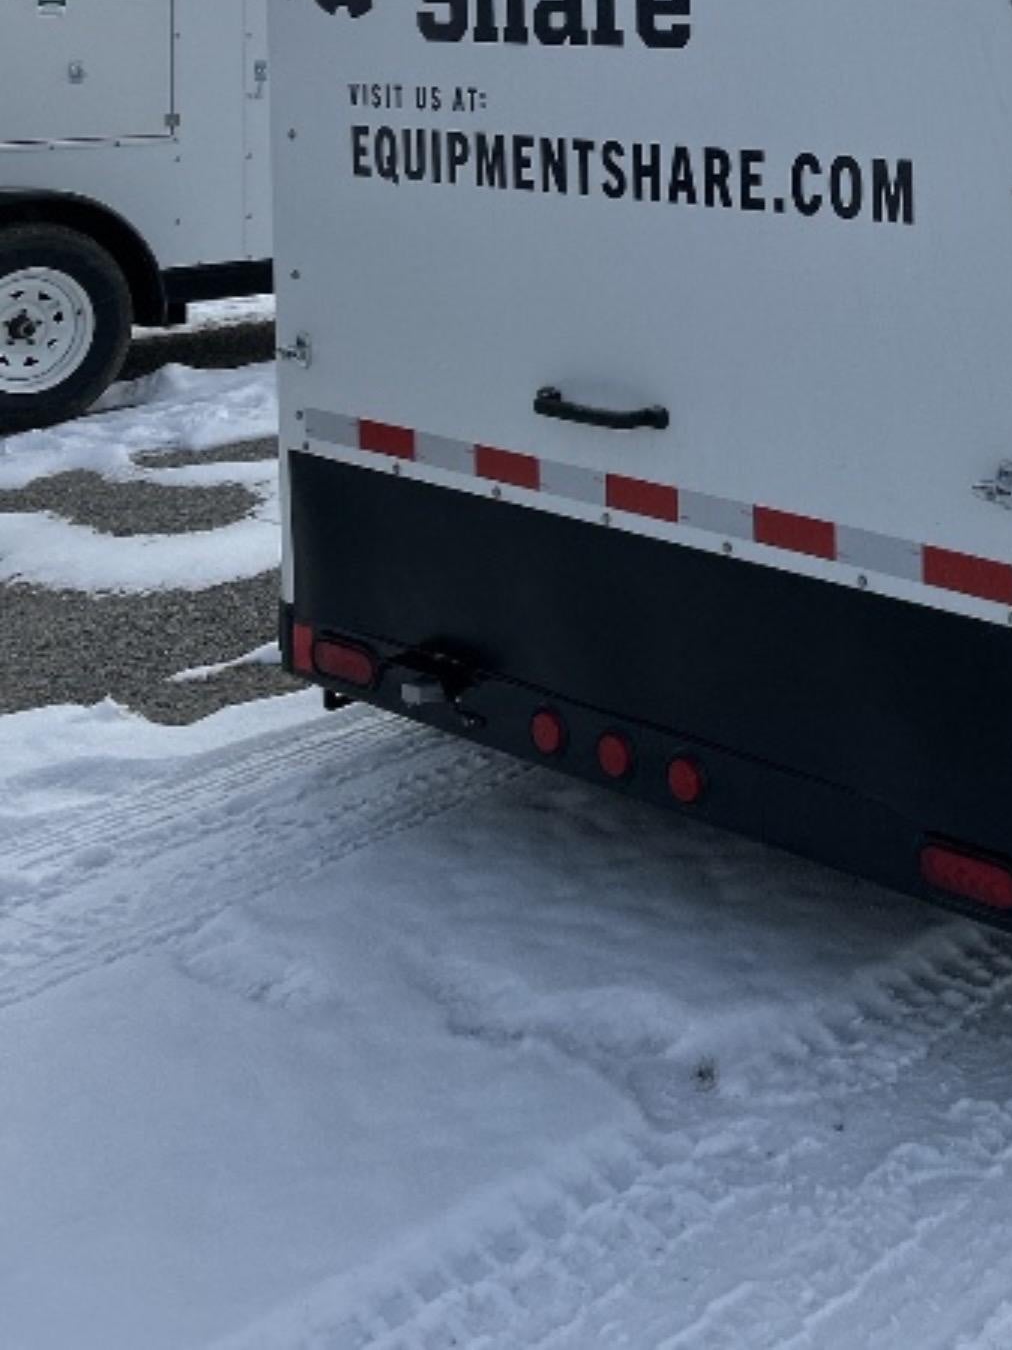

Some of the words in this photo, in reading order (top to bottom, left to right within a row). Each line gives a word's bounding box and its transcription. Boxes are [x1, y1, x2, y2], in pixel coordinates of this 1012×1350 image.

[348, 83, 403, 110] VISIT
[415, 86, 443, 112] US
[452, 87, 489, 113] AT:
[350, 125, 915, 227] EQUIPMENTSHARE.COM
